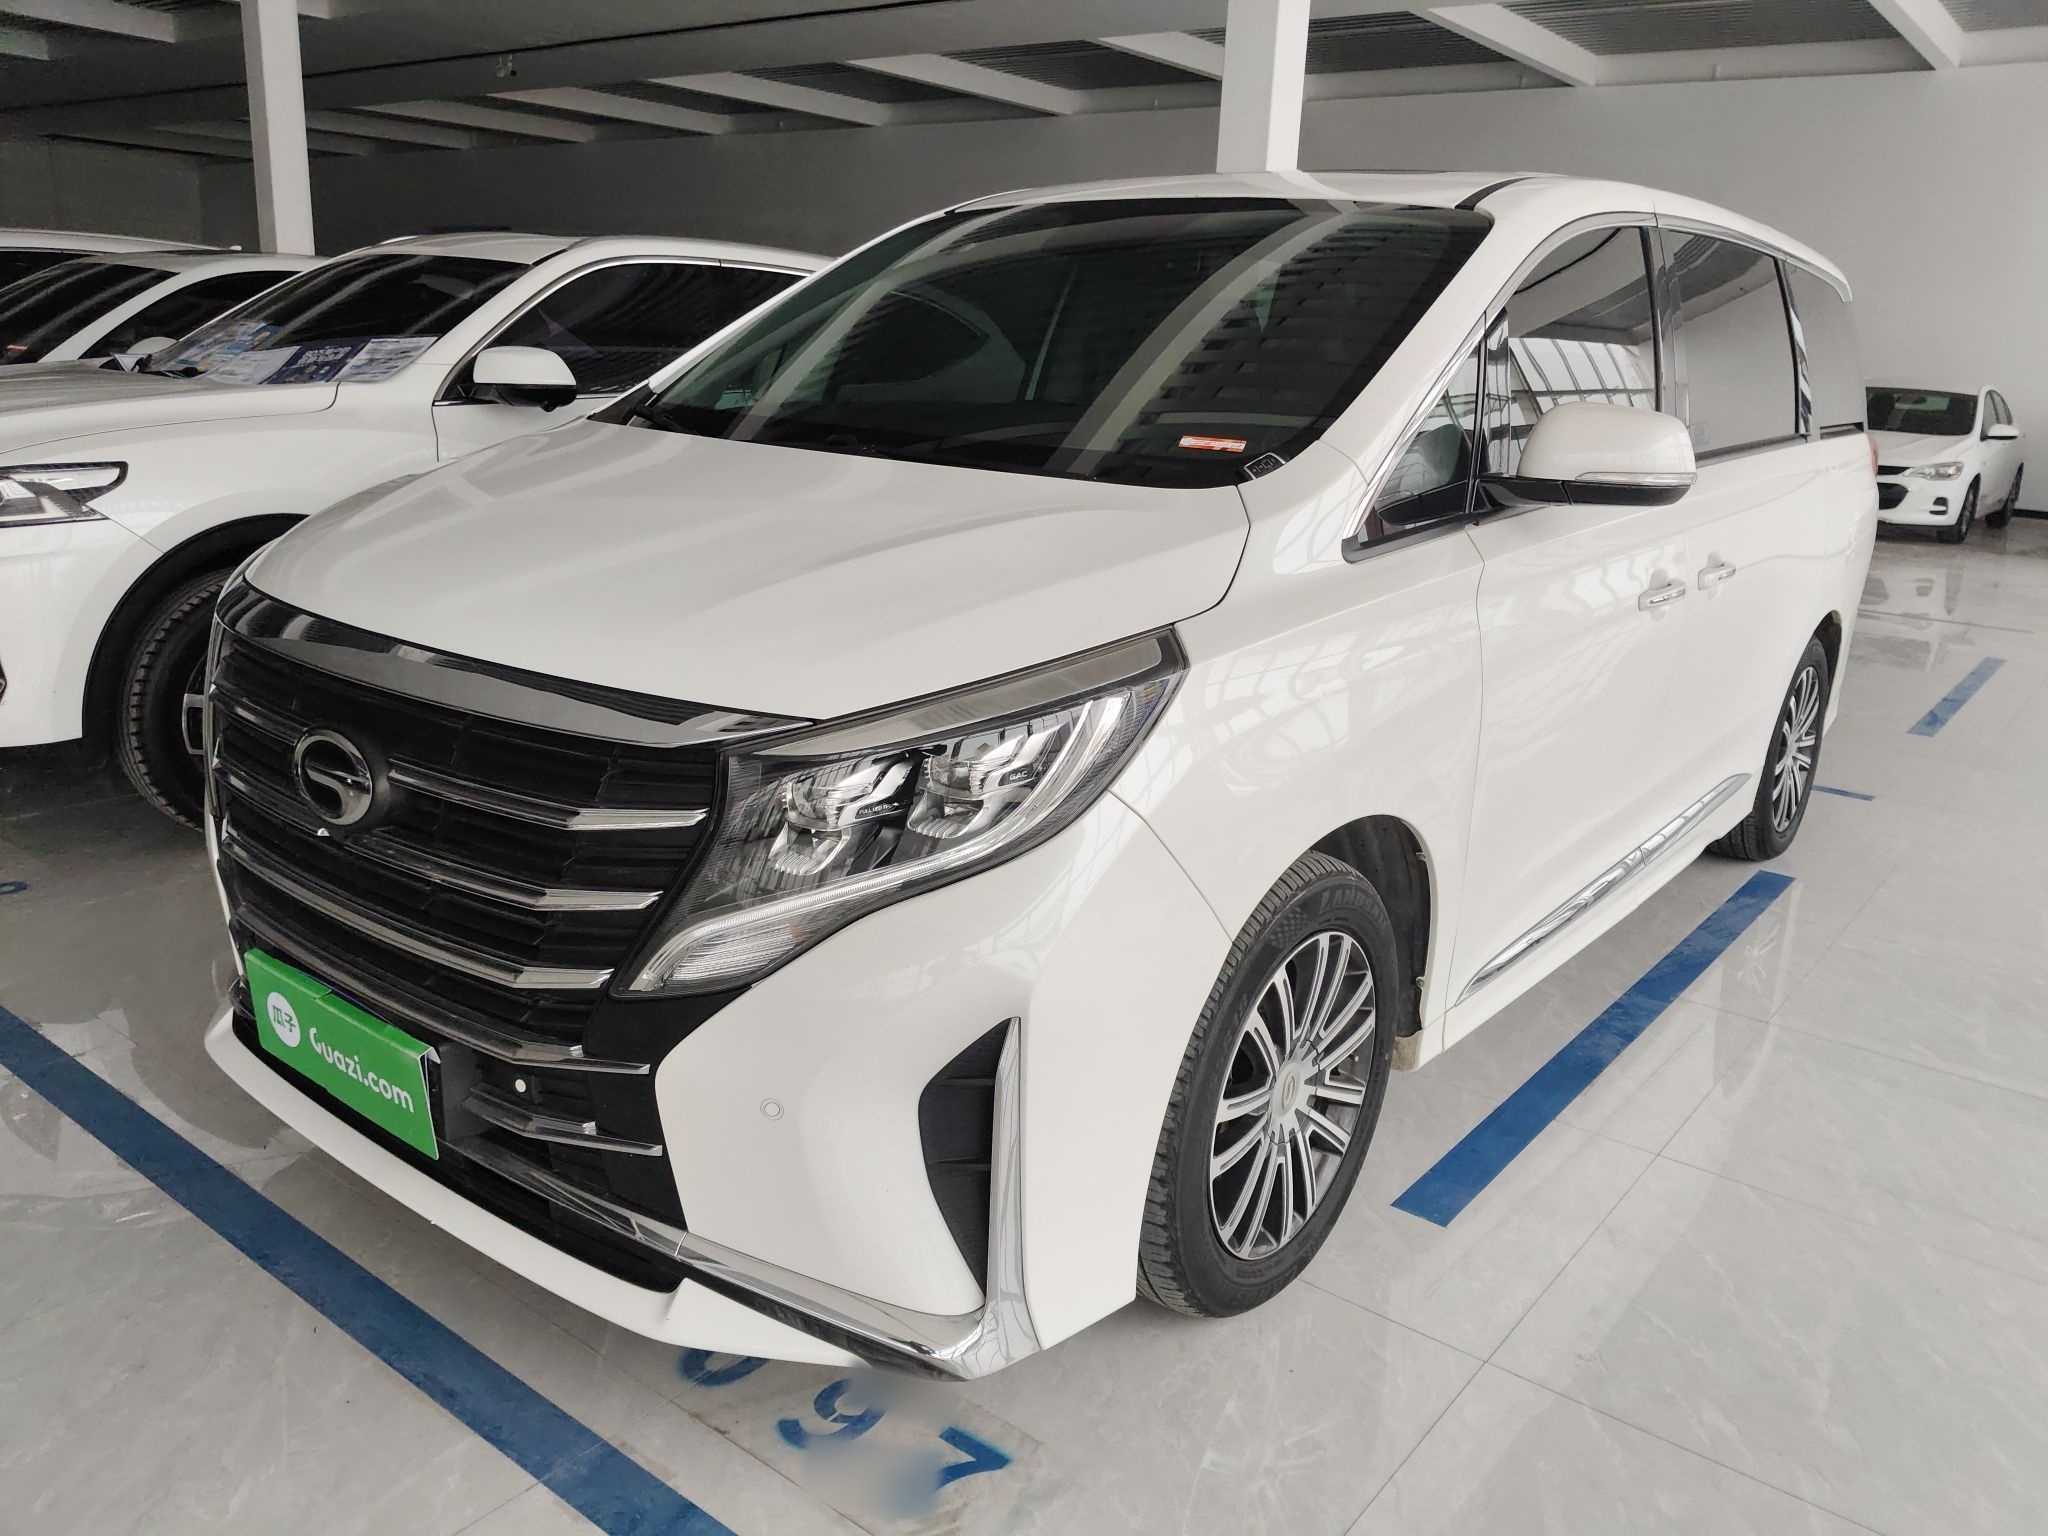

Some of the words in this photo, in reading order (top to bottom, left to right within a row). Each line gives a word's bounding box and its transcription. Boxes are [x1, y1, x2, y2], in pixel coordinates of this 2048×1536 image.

[1009, 770, 1028, 781] GAC
[272, 1004, 297, 1034] 瓜子
[309, 1027, 415, 1113] Guazi.com
